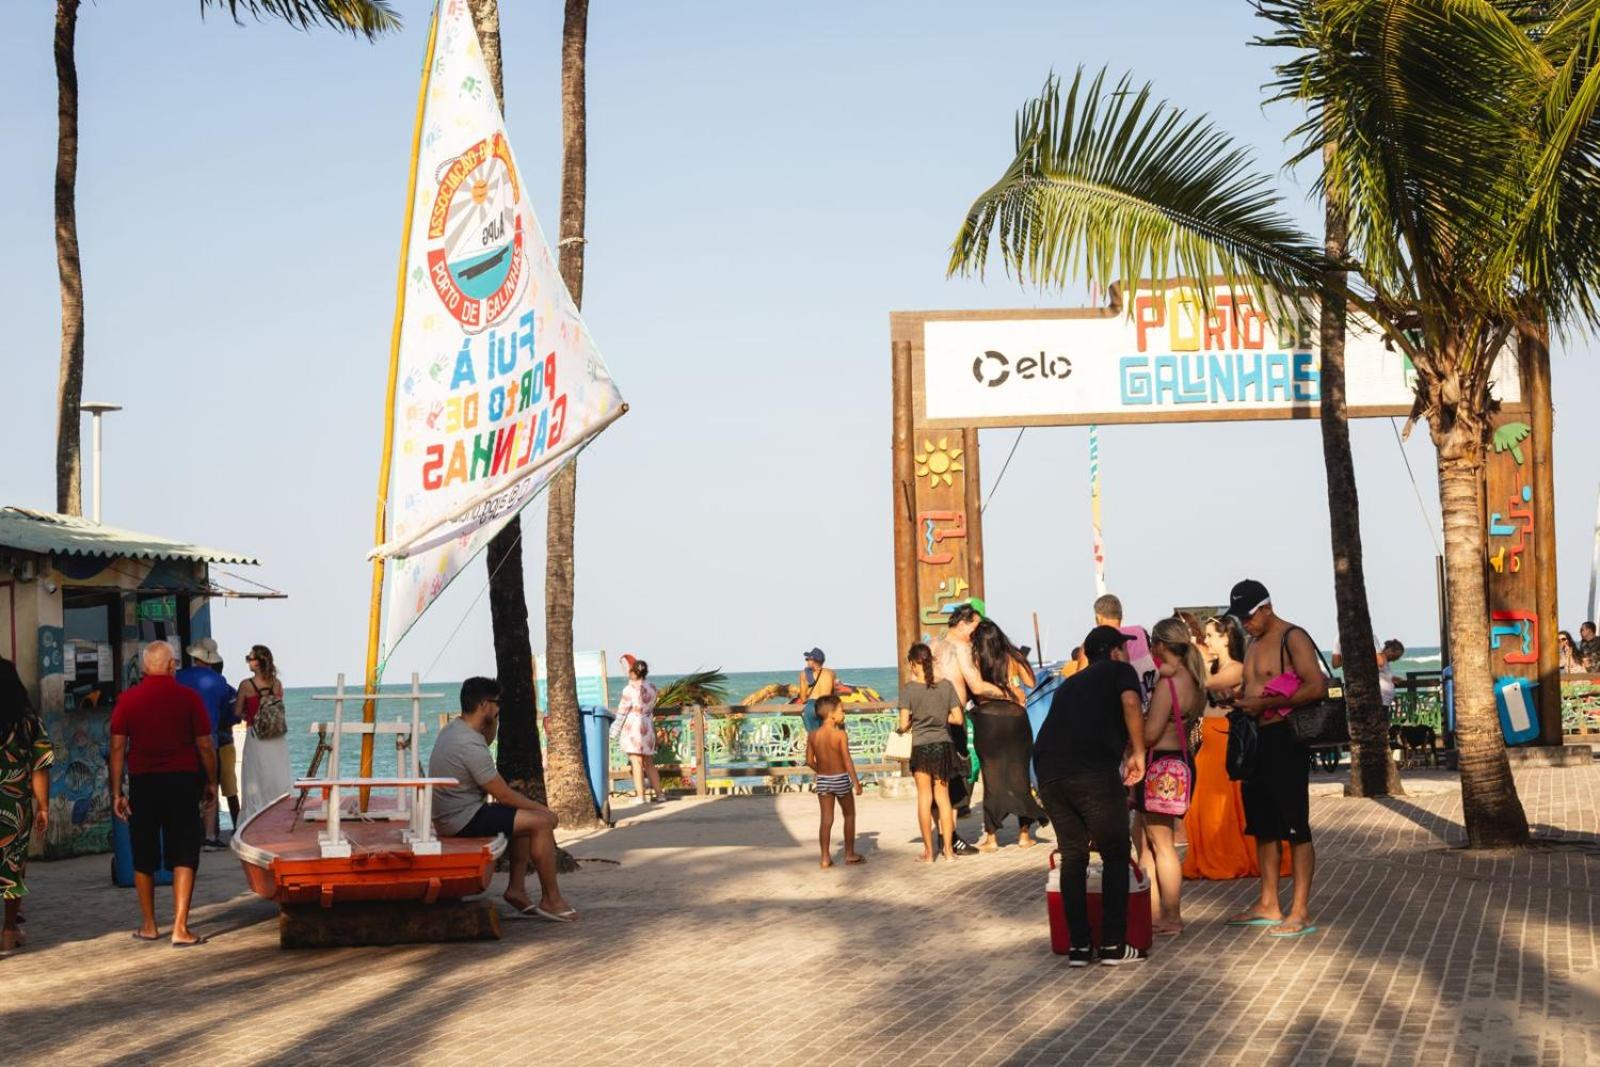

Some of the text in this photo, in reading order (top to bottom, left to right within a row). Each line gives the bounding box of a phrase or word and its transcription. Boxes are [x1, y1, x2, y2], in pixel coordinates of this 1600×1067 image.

[432, 244, 522, 323] PORTO DE GALINHAS
[1136, 290, 1266, 352] PORTO
[1016, 351, 1072, 379] elo
[1119, 353, 1322, 405] GALINHAS
